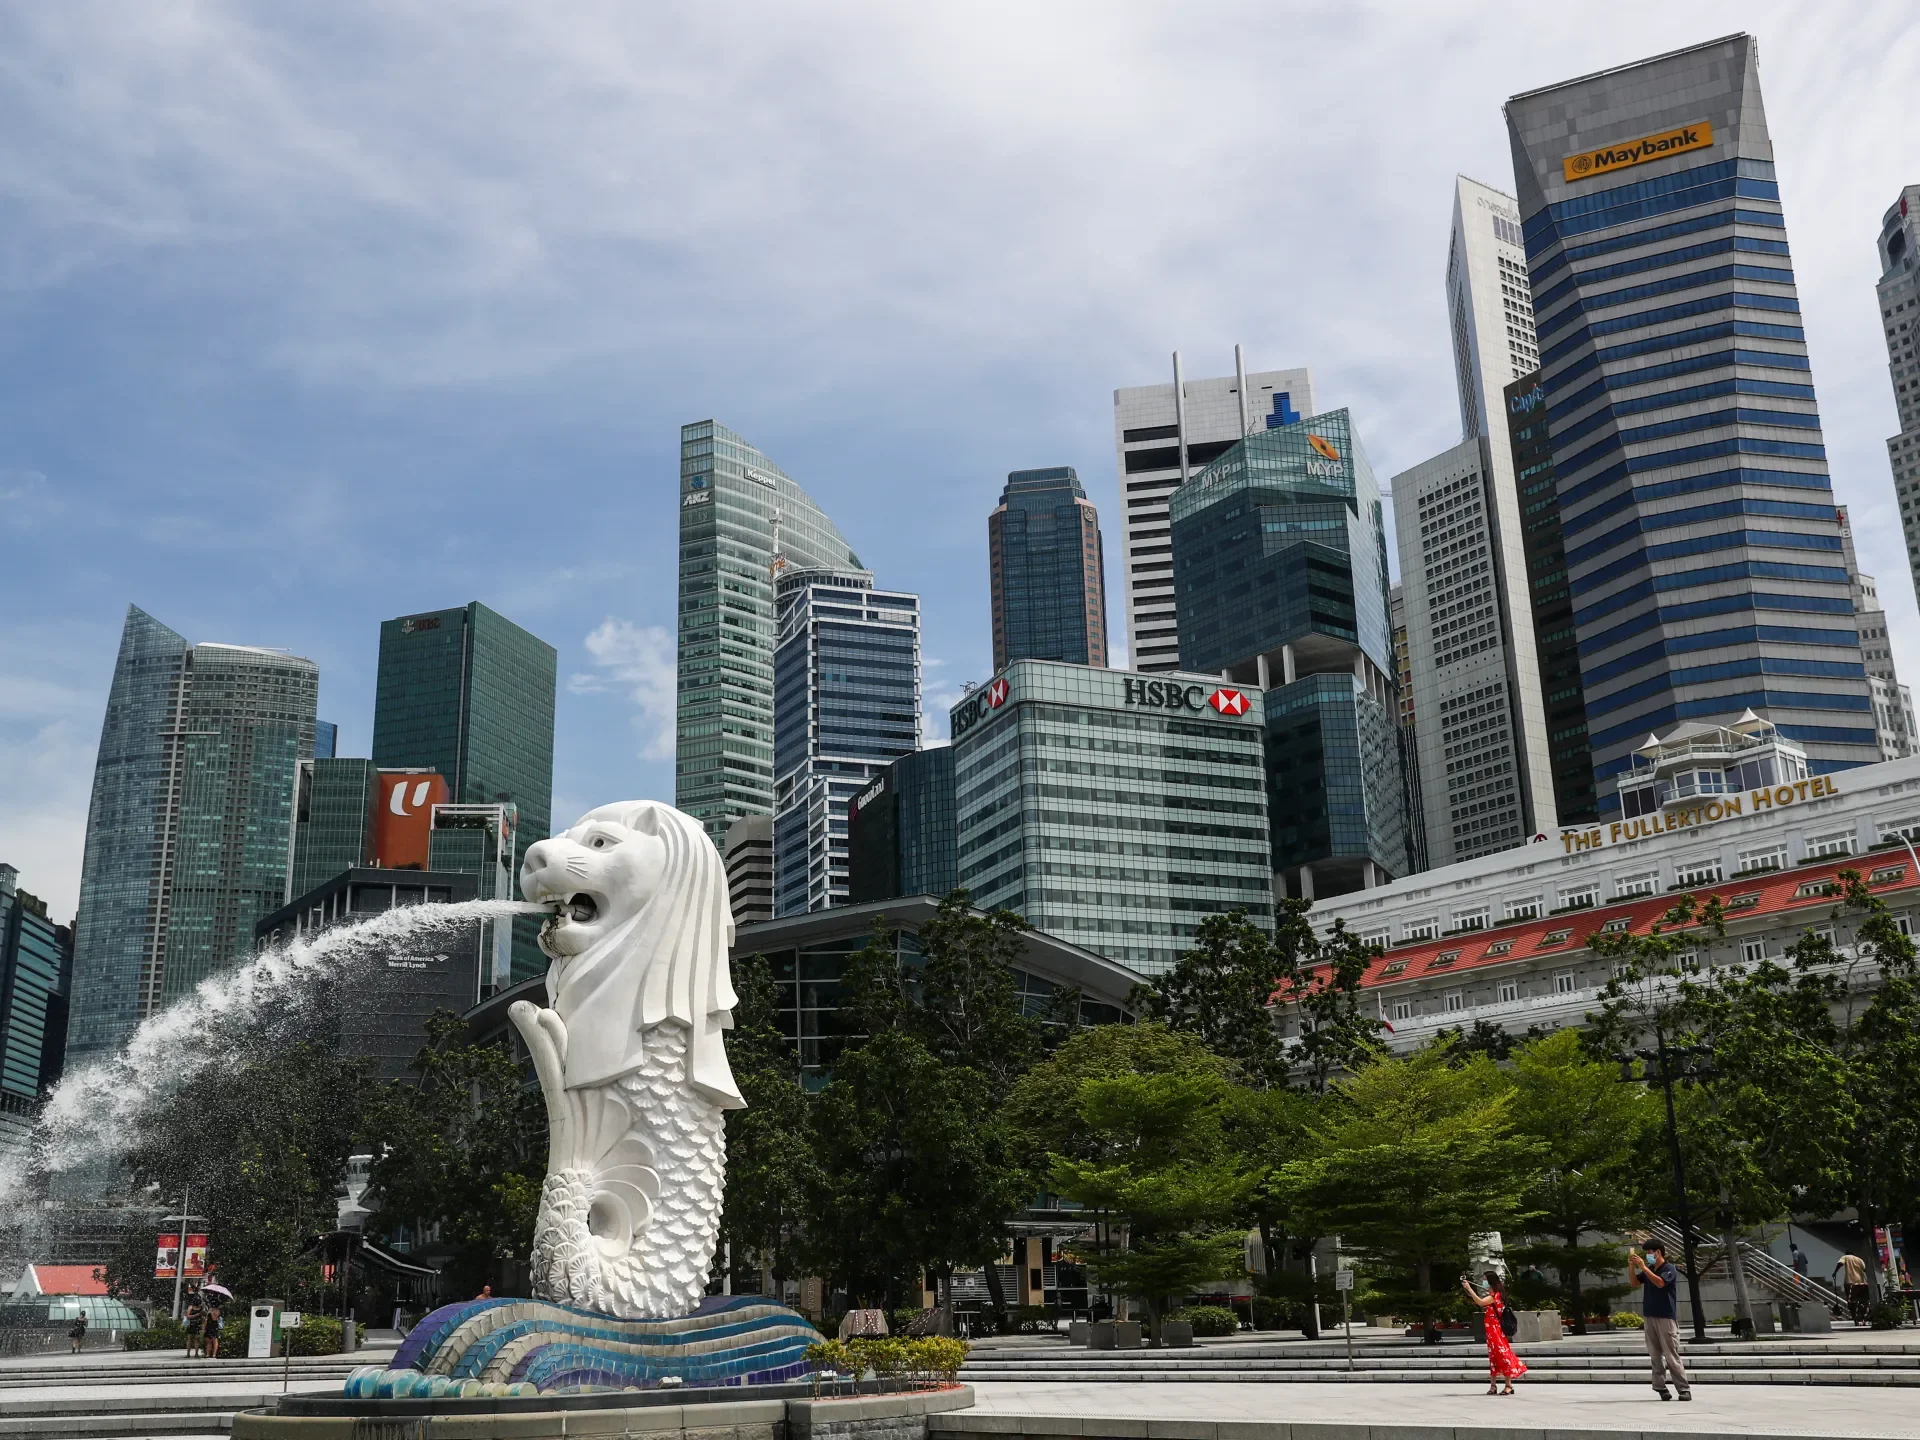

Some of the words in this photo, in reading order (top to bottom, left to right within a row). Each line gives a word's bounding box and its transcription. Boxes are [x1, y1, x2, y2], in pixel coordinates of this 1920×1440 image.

[1594, 129, 1699, 168] Maybank
[747, 468, 777, 487] Keppel
[1201, 463, 1231, 490] MYP
[1306, 461, 1343, 478] MYP
[683, 491, 711, 507] ANZ
[1123, 677, 1206, 711] HSBC
[950, 689, 989, 740] HSBC
[1560, 828, 1602, 853] THE
[1610, 796, 1742, 843] FULLERTON
[1752, 775, 1839, 811] HOTEL
